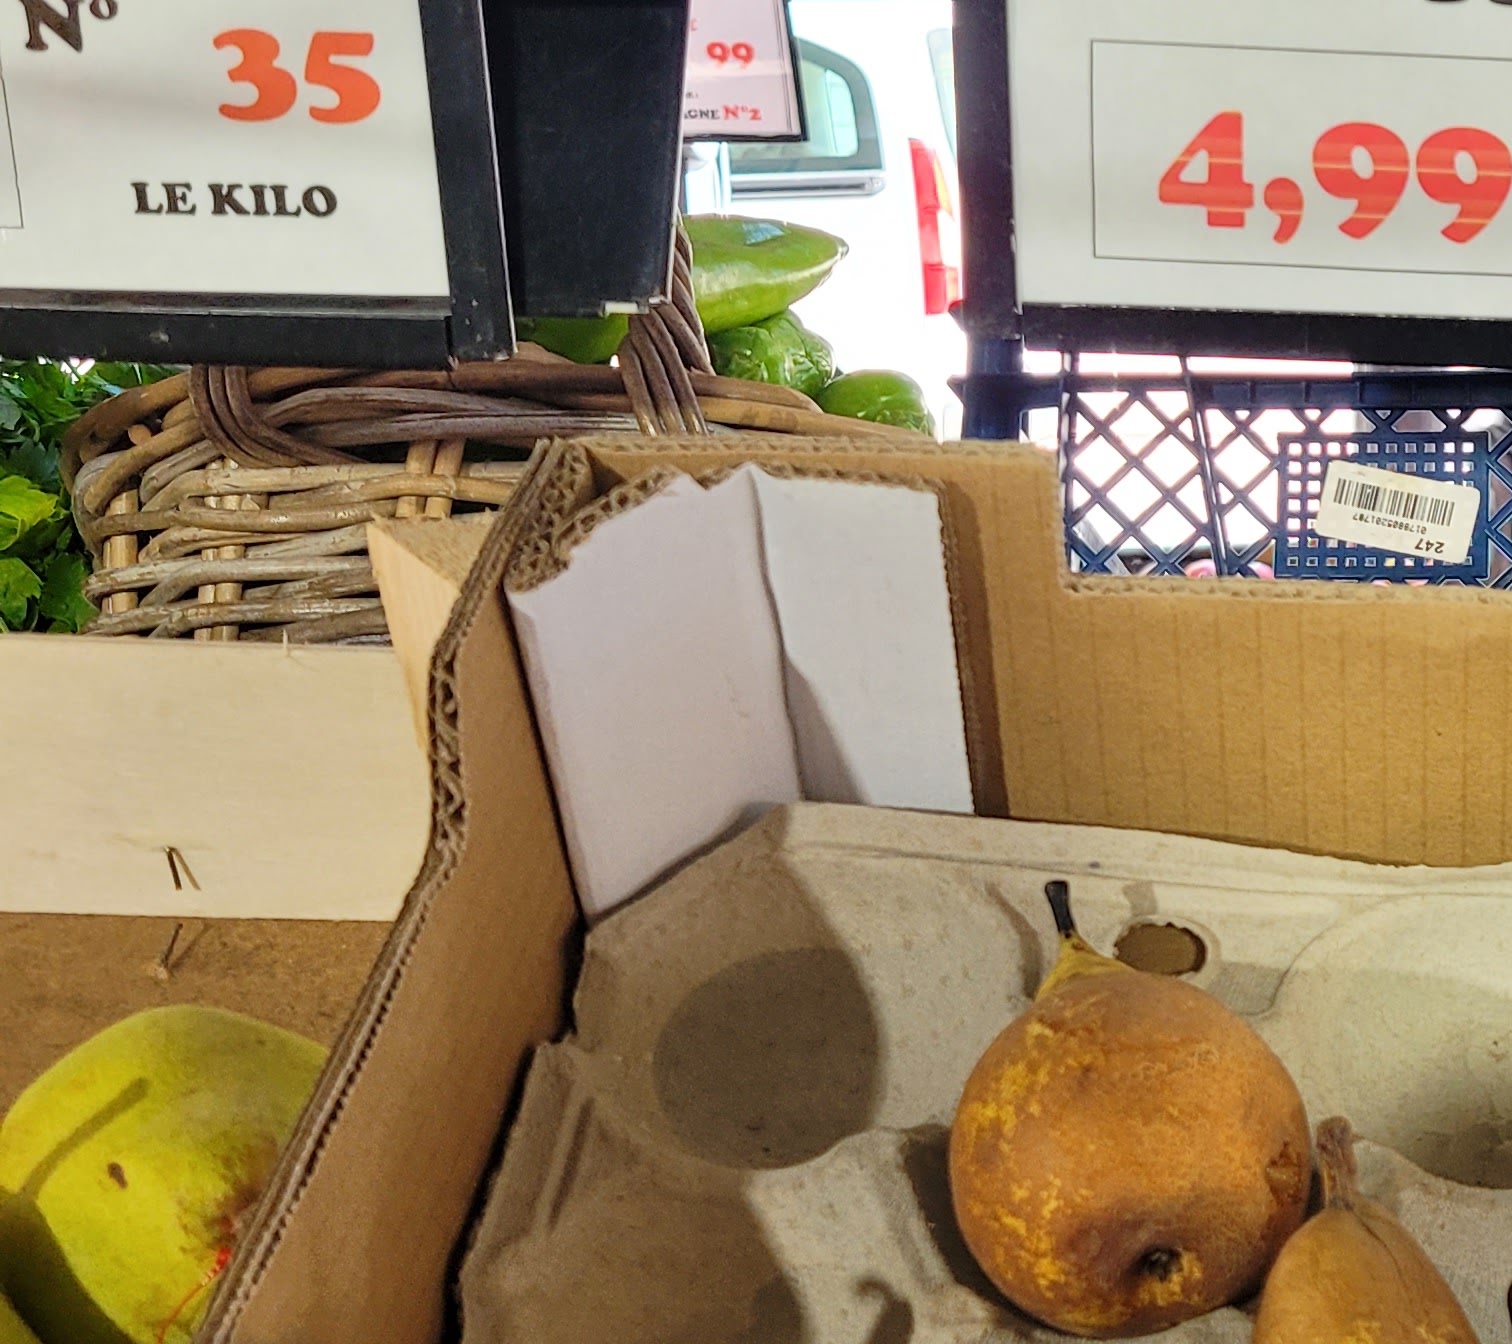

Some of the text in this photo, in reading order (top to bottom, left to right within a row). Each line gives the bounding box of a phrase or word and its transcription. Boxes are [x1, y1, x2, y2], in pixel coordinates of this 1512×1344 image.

[706, 42, 755, 69] 99
[212, 28, 382, 125] 35
[130, 182, 338, 218] LE KILO
[1414, 538, 1445, 554] 247
